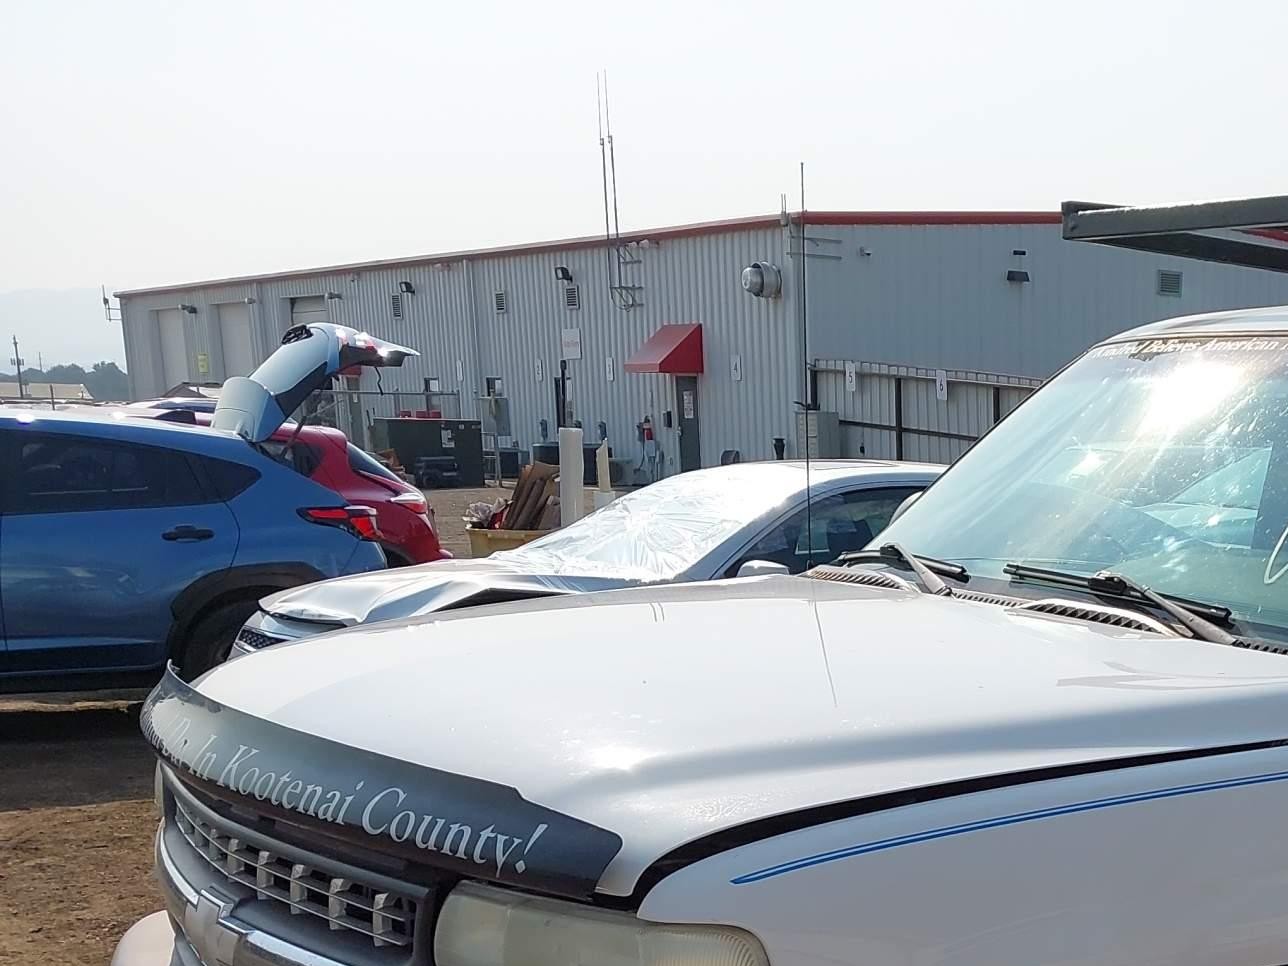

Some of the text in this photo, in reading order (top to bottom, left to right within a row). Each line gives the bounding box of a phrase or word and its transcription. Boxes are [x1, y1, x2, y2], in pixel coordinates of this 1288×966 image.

[1199, 338, 1279, 352] American
[848, 371, 853, 384] 5
[939, 378, 944, 392] 6
[188, 734, 217, 781] In
[216, 743, 364, 826] Kootenai
[362, 787, 549, 878] County!
